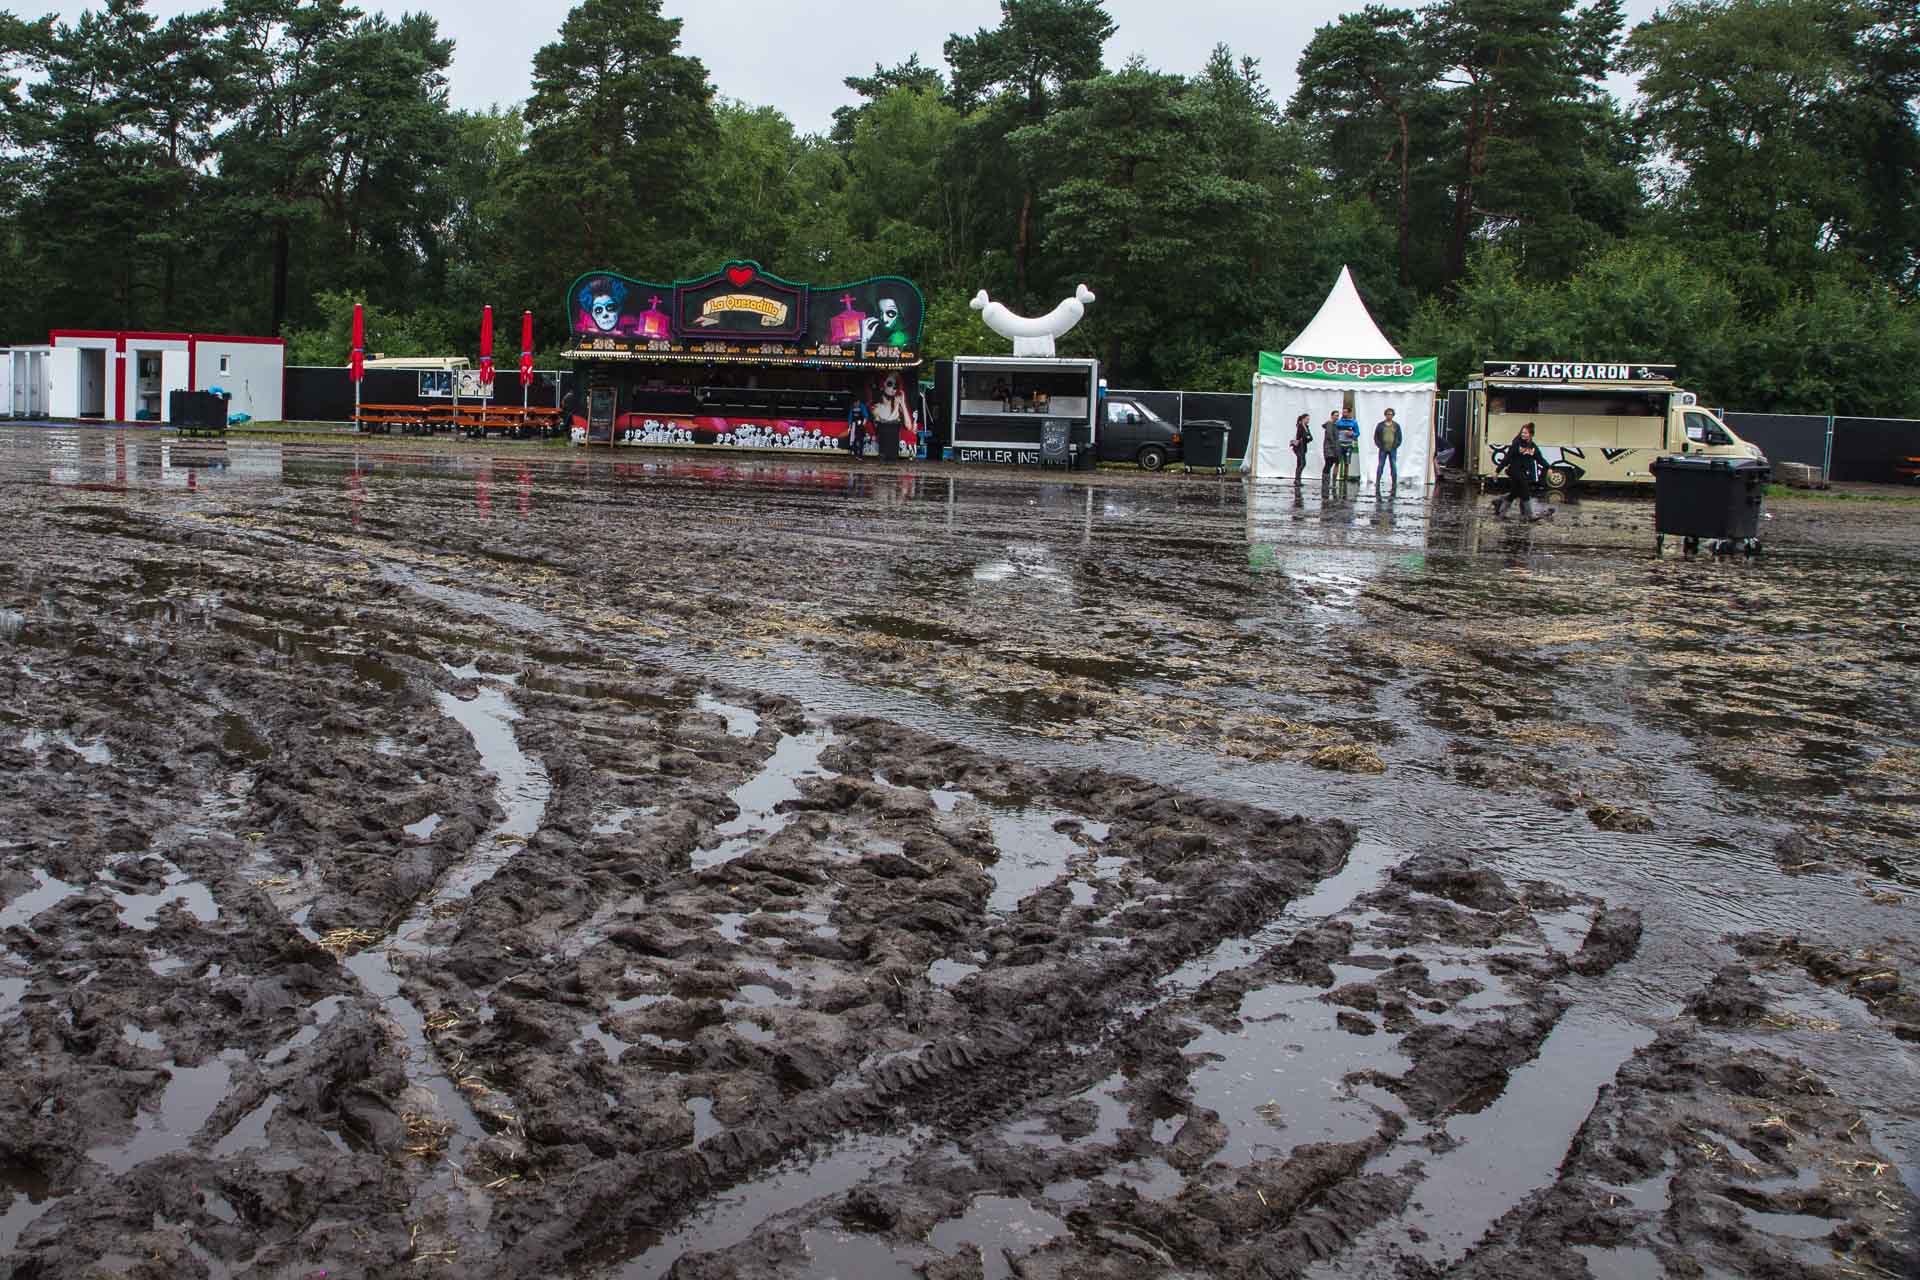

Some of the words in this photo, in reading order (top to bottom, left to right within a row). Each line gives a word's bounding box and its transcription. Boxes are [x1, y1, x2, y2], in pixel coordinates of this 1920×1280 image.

[711, 301, 724, 310] La
[726, 297, 779, 316] Quesadilla
[1282, 356, 1414, 378] Bio-Crêperie
[1528, 364, 1629, 380] HACKBARON
[961, 449, 1012, 464] GRILLER
[1017, 451, 1078, 464] INST
